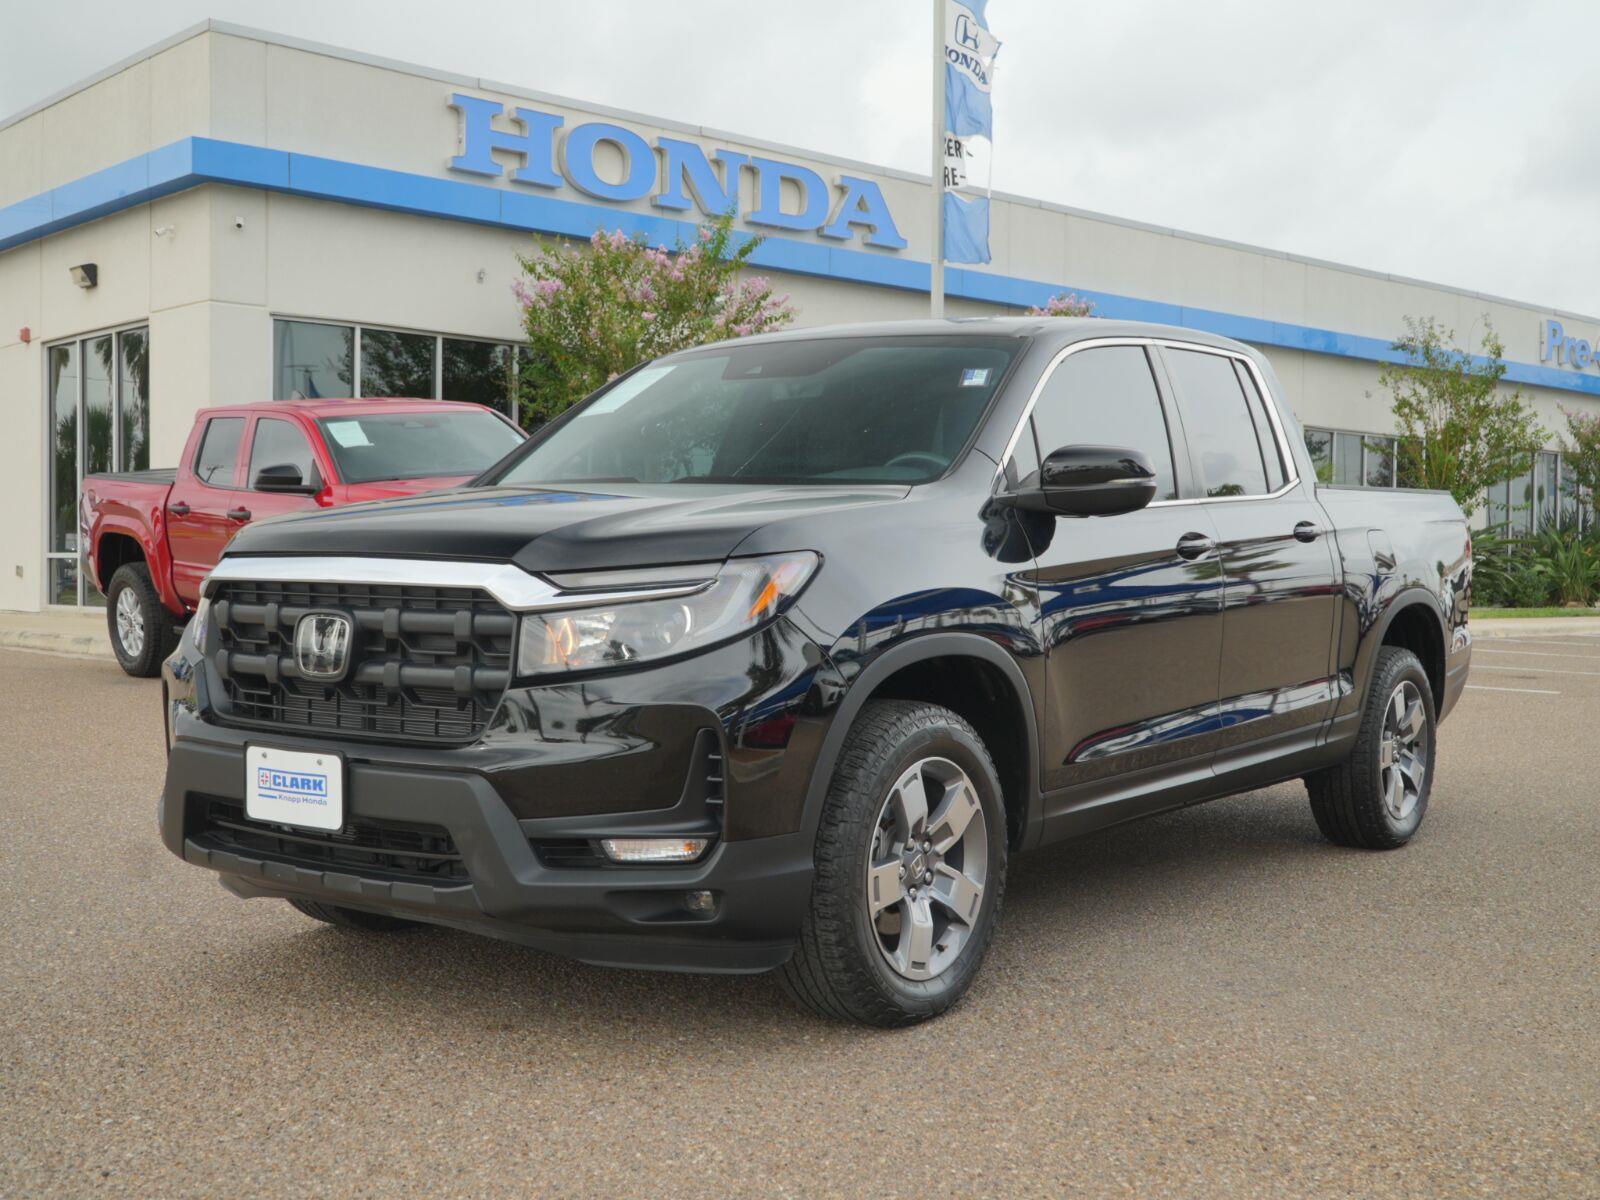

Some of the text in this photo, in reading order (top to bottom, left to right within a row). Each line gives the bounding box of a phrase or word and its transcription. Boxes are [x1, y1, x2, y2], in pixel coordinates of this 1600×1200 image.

[449, 92, 908, 249] HONDA
[272, 774, 324, 791] CLARK
[302, 797, 327, 806] Honda
